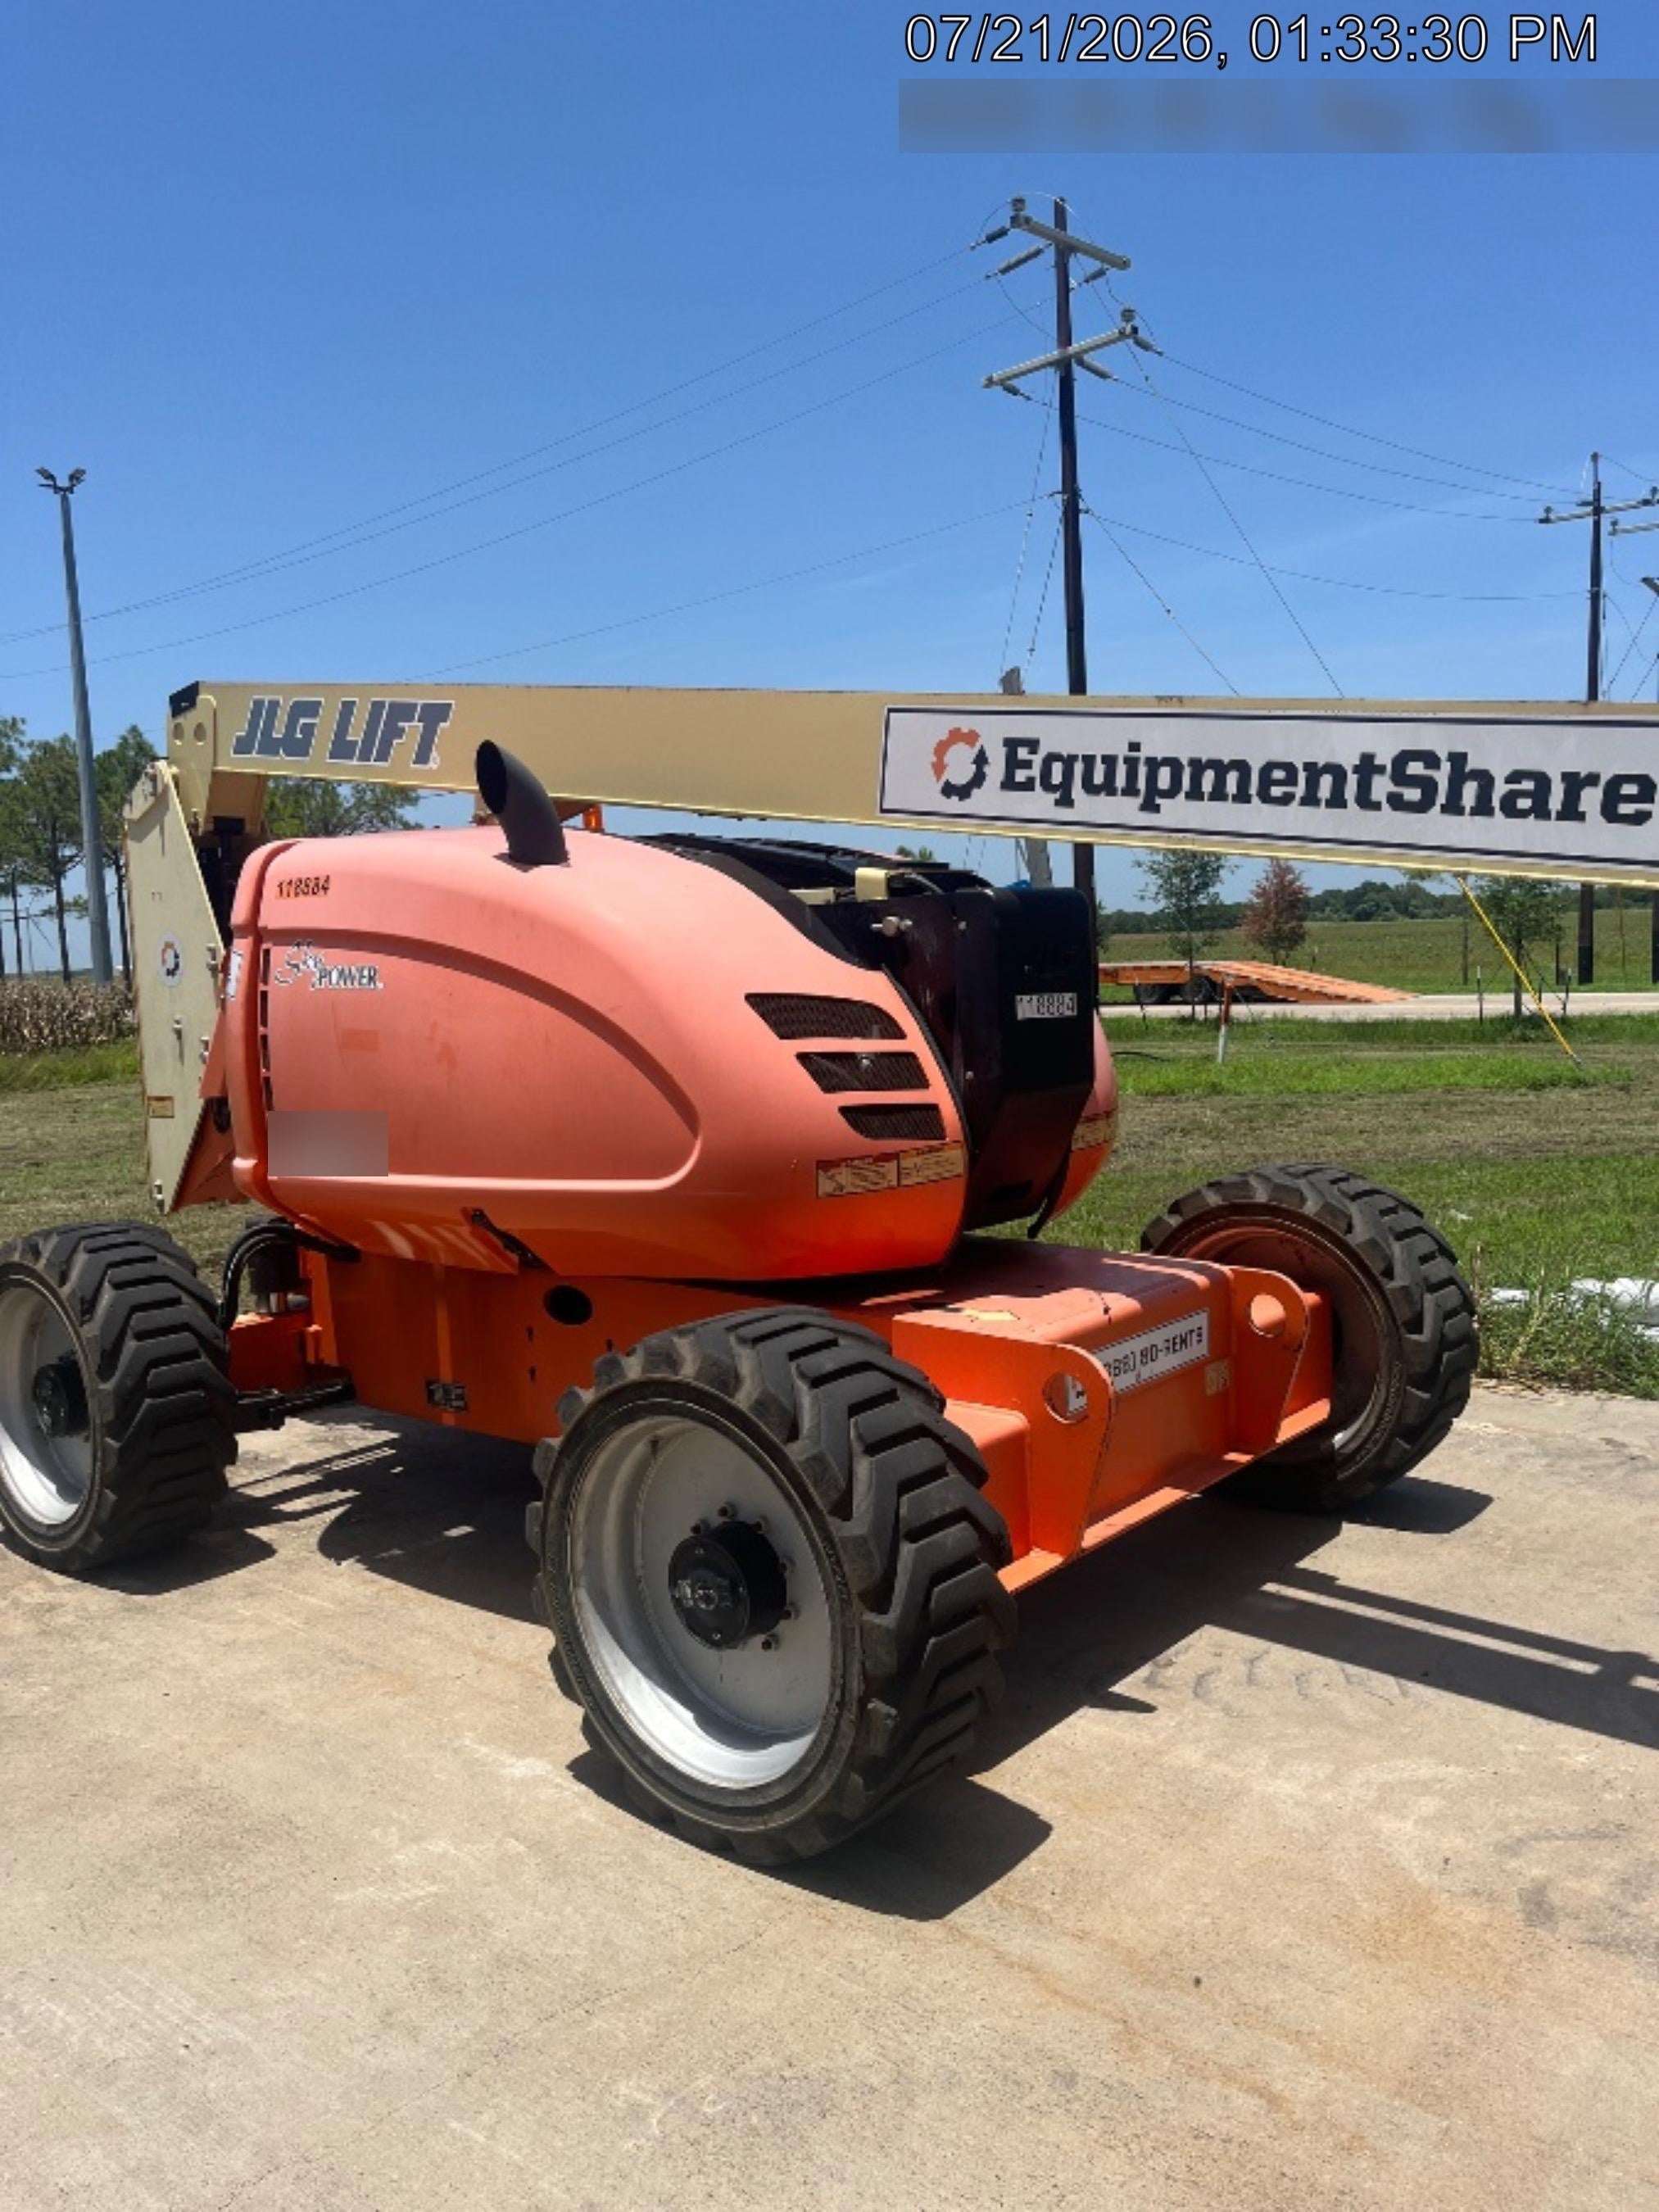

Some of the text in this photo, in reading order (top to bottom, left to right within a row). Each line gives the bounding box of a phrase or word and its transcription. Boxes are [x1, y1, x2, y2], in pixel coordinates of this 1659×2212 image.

[231, 696, 455, 769] JLG LIFT
[999, 737, 1658, 826] EquipmentShare
